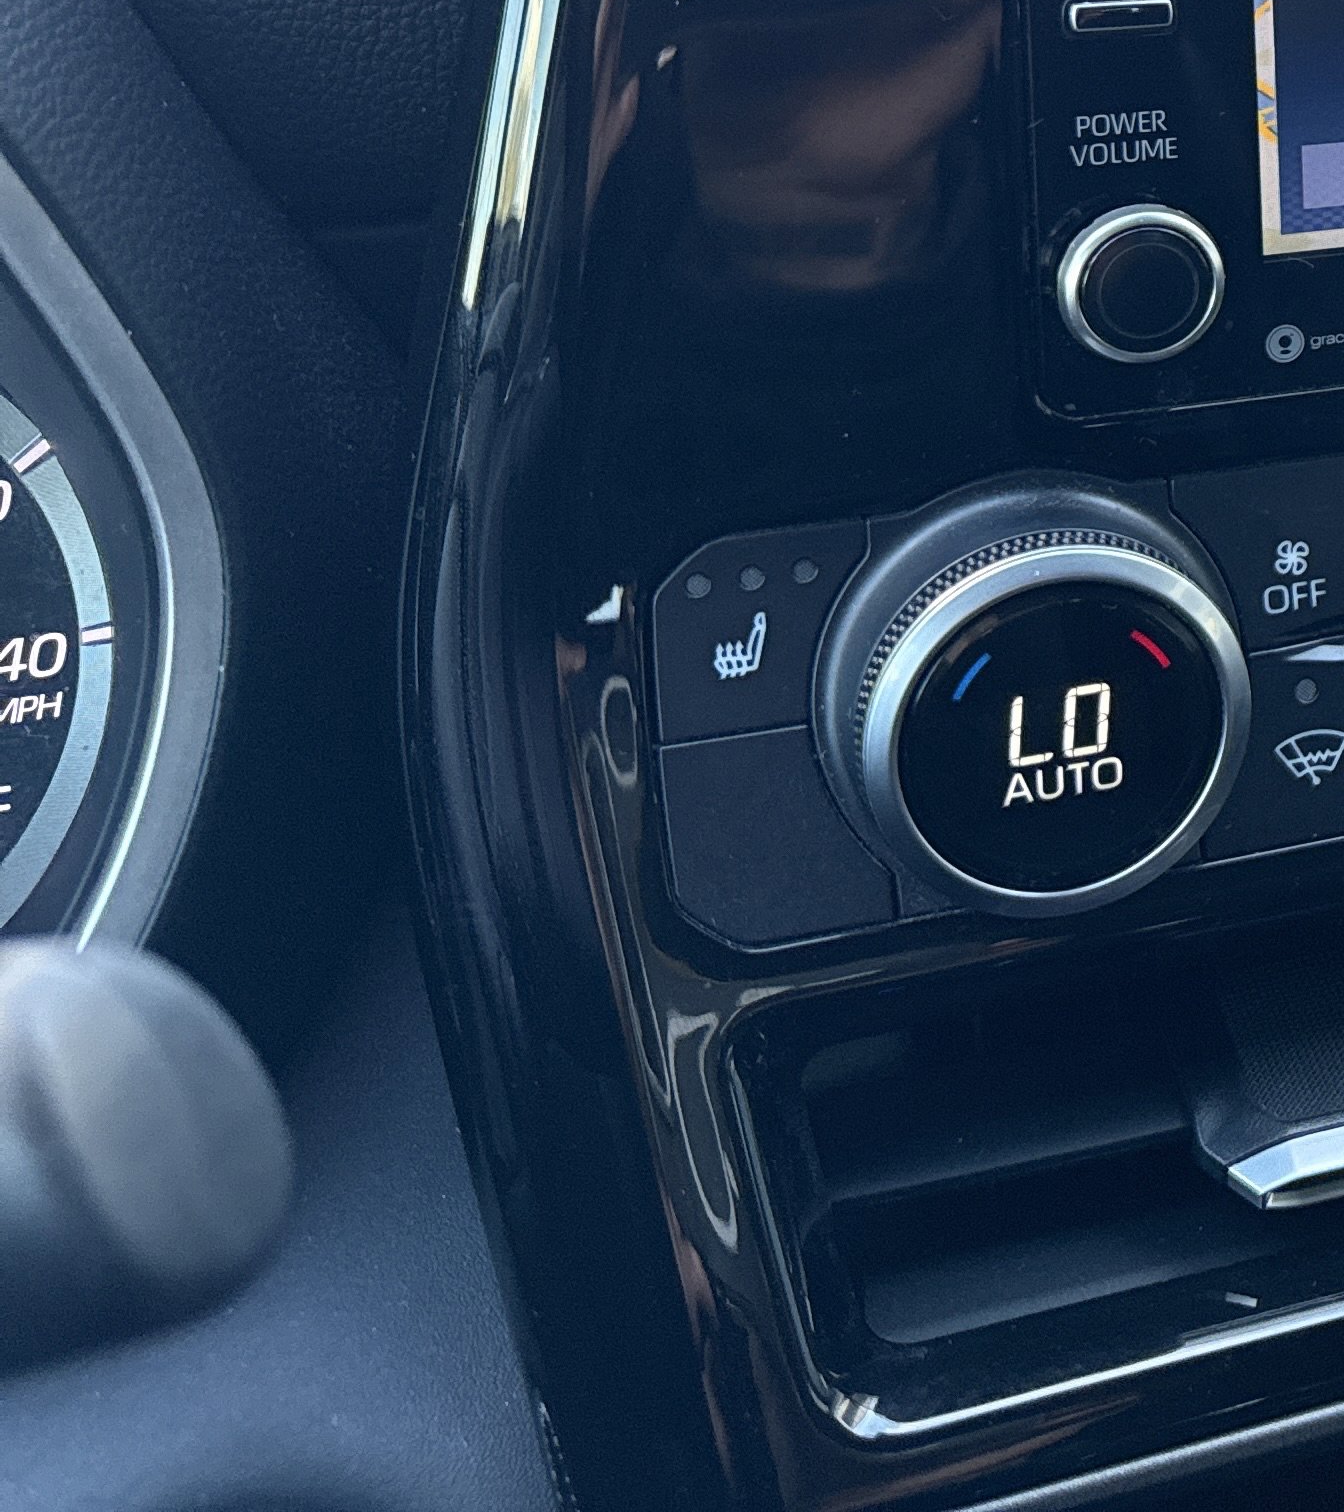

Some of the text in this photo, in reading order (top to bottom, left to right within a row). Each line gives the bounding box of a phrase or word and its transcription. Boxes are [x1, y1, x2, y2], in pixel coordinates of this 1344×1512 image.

[1075, 110, 1167, 138] POWER
[1070, 137, 1178, 167] VOLUME
[1264, 578, 1327, 615] OFF
[1008, 682, 1110, 770] LO
[1003, 756, 1124, 808] AUTO
